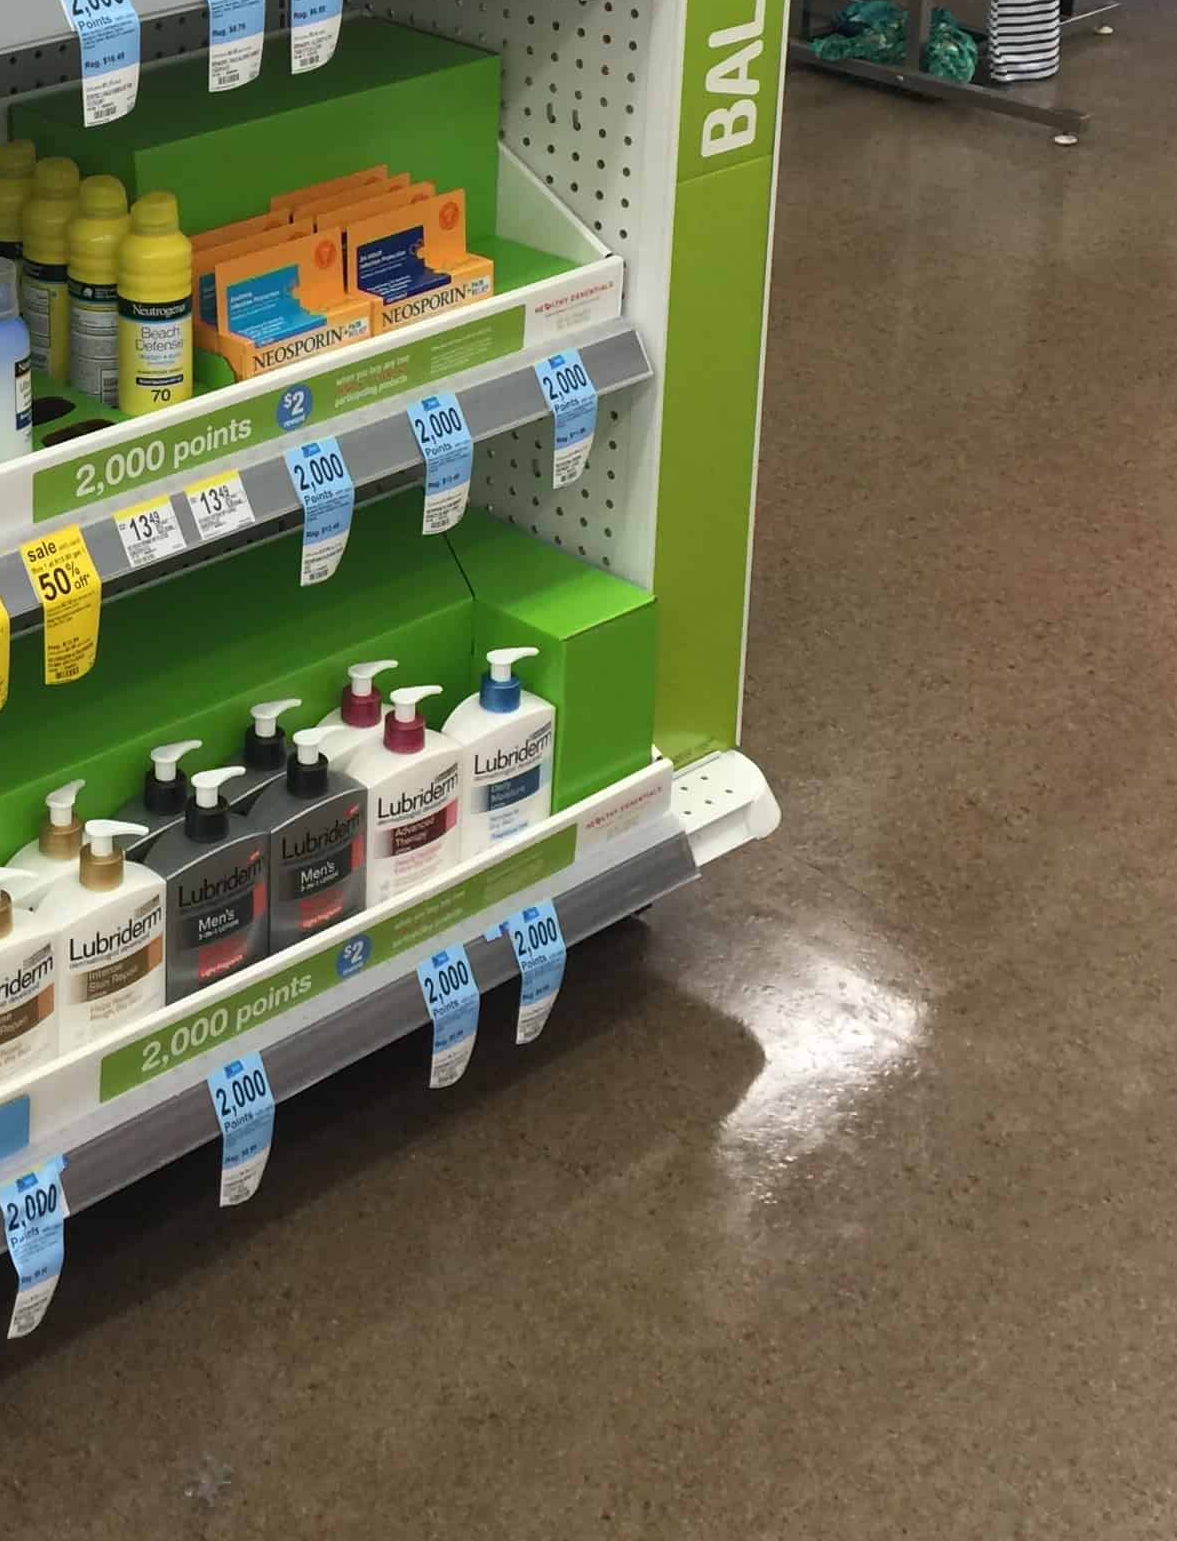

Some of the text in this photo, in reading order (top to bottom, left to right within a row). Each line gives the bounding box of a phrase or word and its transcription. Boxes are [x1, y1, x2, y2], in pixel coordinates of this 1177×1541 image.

[132, 303, 186, 318] Neutrogena
[382, 285, 467, 327] NEOSPORIN
[135, 339, 183, 352] Defense
[141, 325, 181, 341] Beach
[254, 326, 343, 371] NEOSPORIN
[151, 389, 171, 402] 70
[543, 364, 587, 400] 2,000
[283, 391, 305, 416] $2
[415, 408, 462, 443] 2,000
[76, 417, 252, 497] 2,000 points
[294, 453, 344, 490] 2,000
[27, 542, 57, 564] sale
[38, 563, 81, 601] 50%
[474, 733, 551, 775] Lubriderm
[378, 773, 459, 819] Lubriderm
[282, 813, 361, 859] Lubriderm
[178, 862, 263, 908] Lubriderm
[301, 861, 335, 884] Men's
[69, 906, 162, 961] Lubriderm
[199, 909, 235, 933] Men's
[514, 917, 558, 956] 2,000
[424, 961, 470, 1006] 2,000
[141, 973, 312, 1072] 2,000 points
[216, 1070, 266, 1118] 2,000
